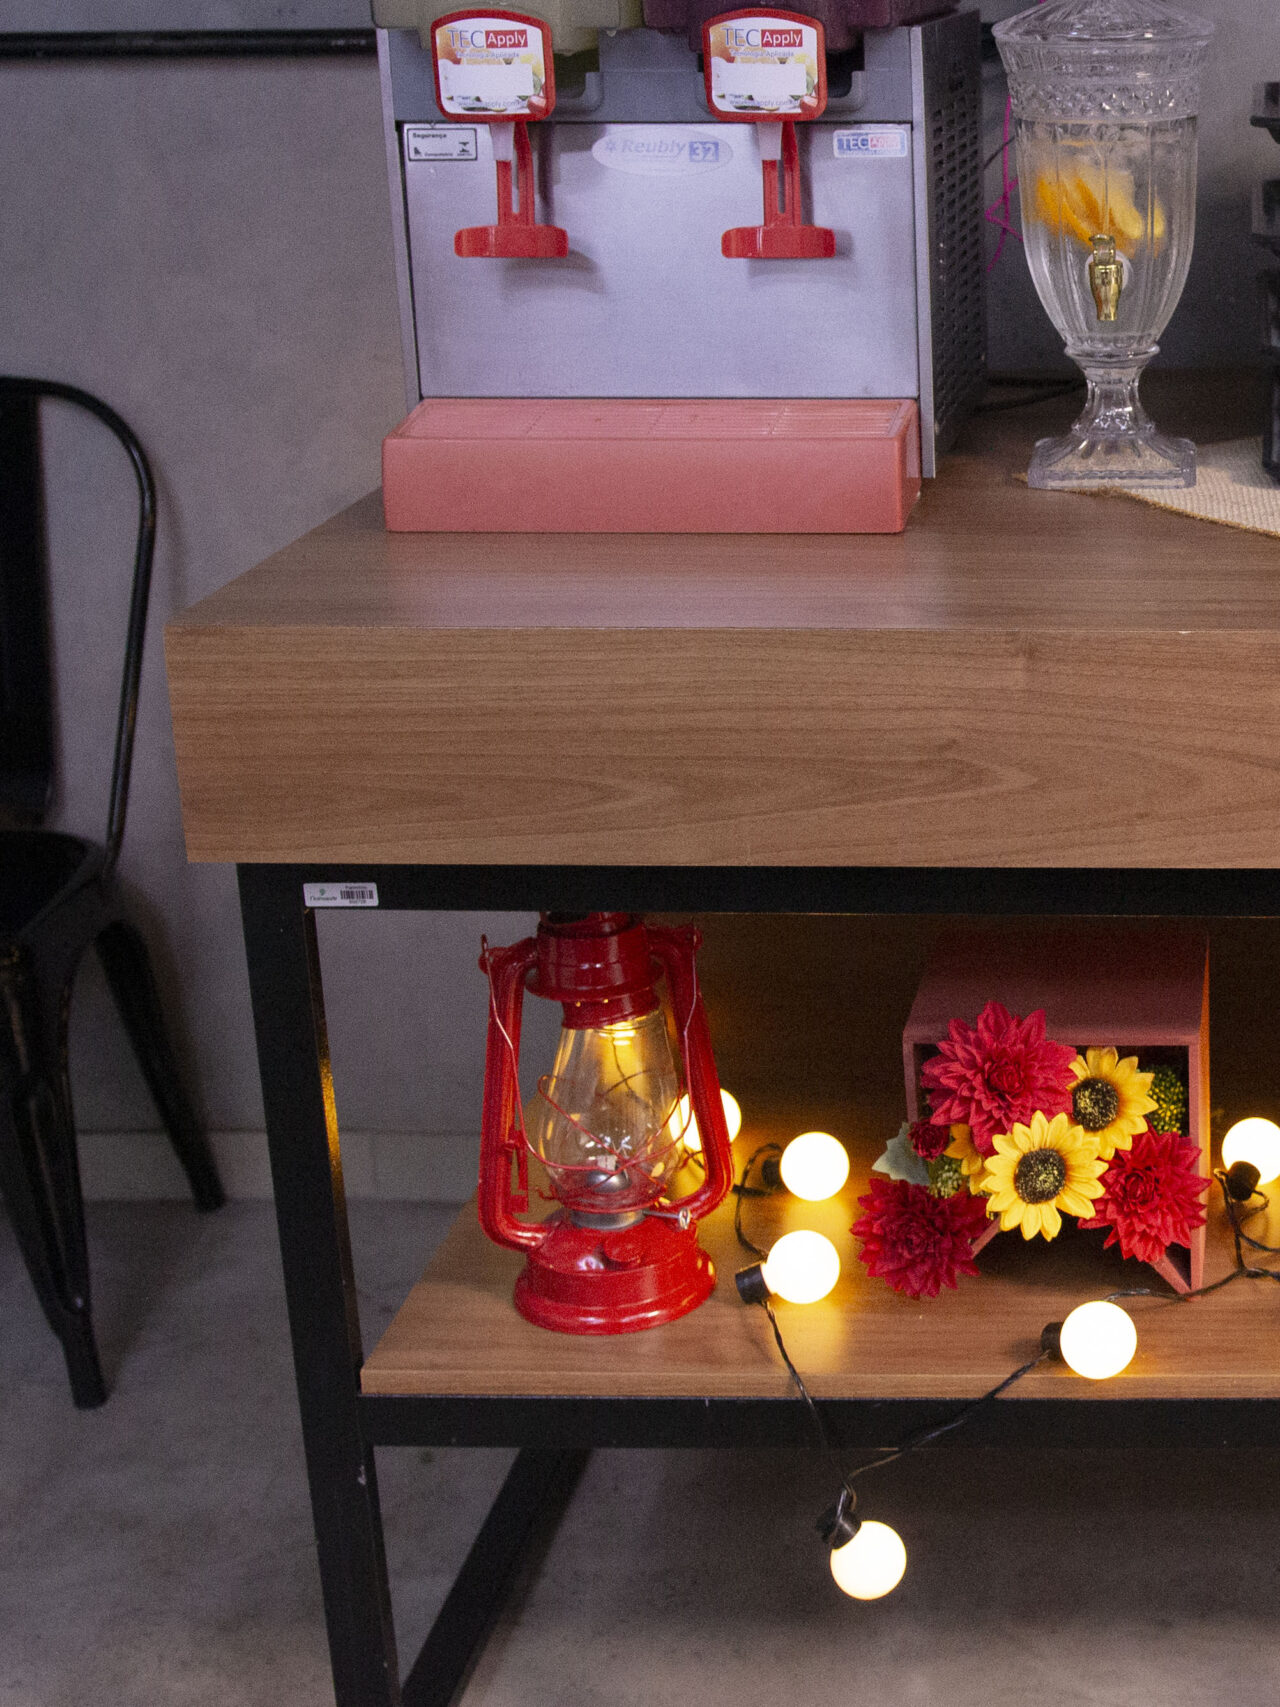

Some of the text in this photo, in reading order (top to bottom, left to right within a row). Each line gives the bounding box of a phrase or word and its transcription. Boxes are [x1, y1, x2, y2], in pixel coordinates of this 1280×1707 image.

[487, 31, 526, 47] Apply
[762, 31, 801, 46] Apply
[842, 135, 868, 149] TEC
